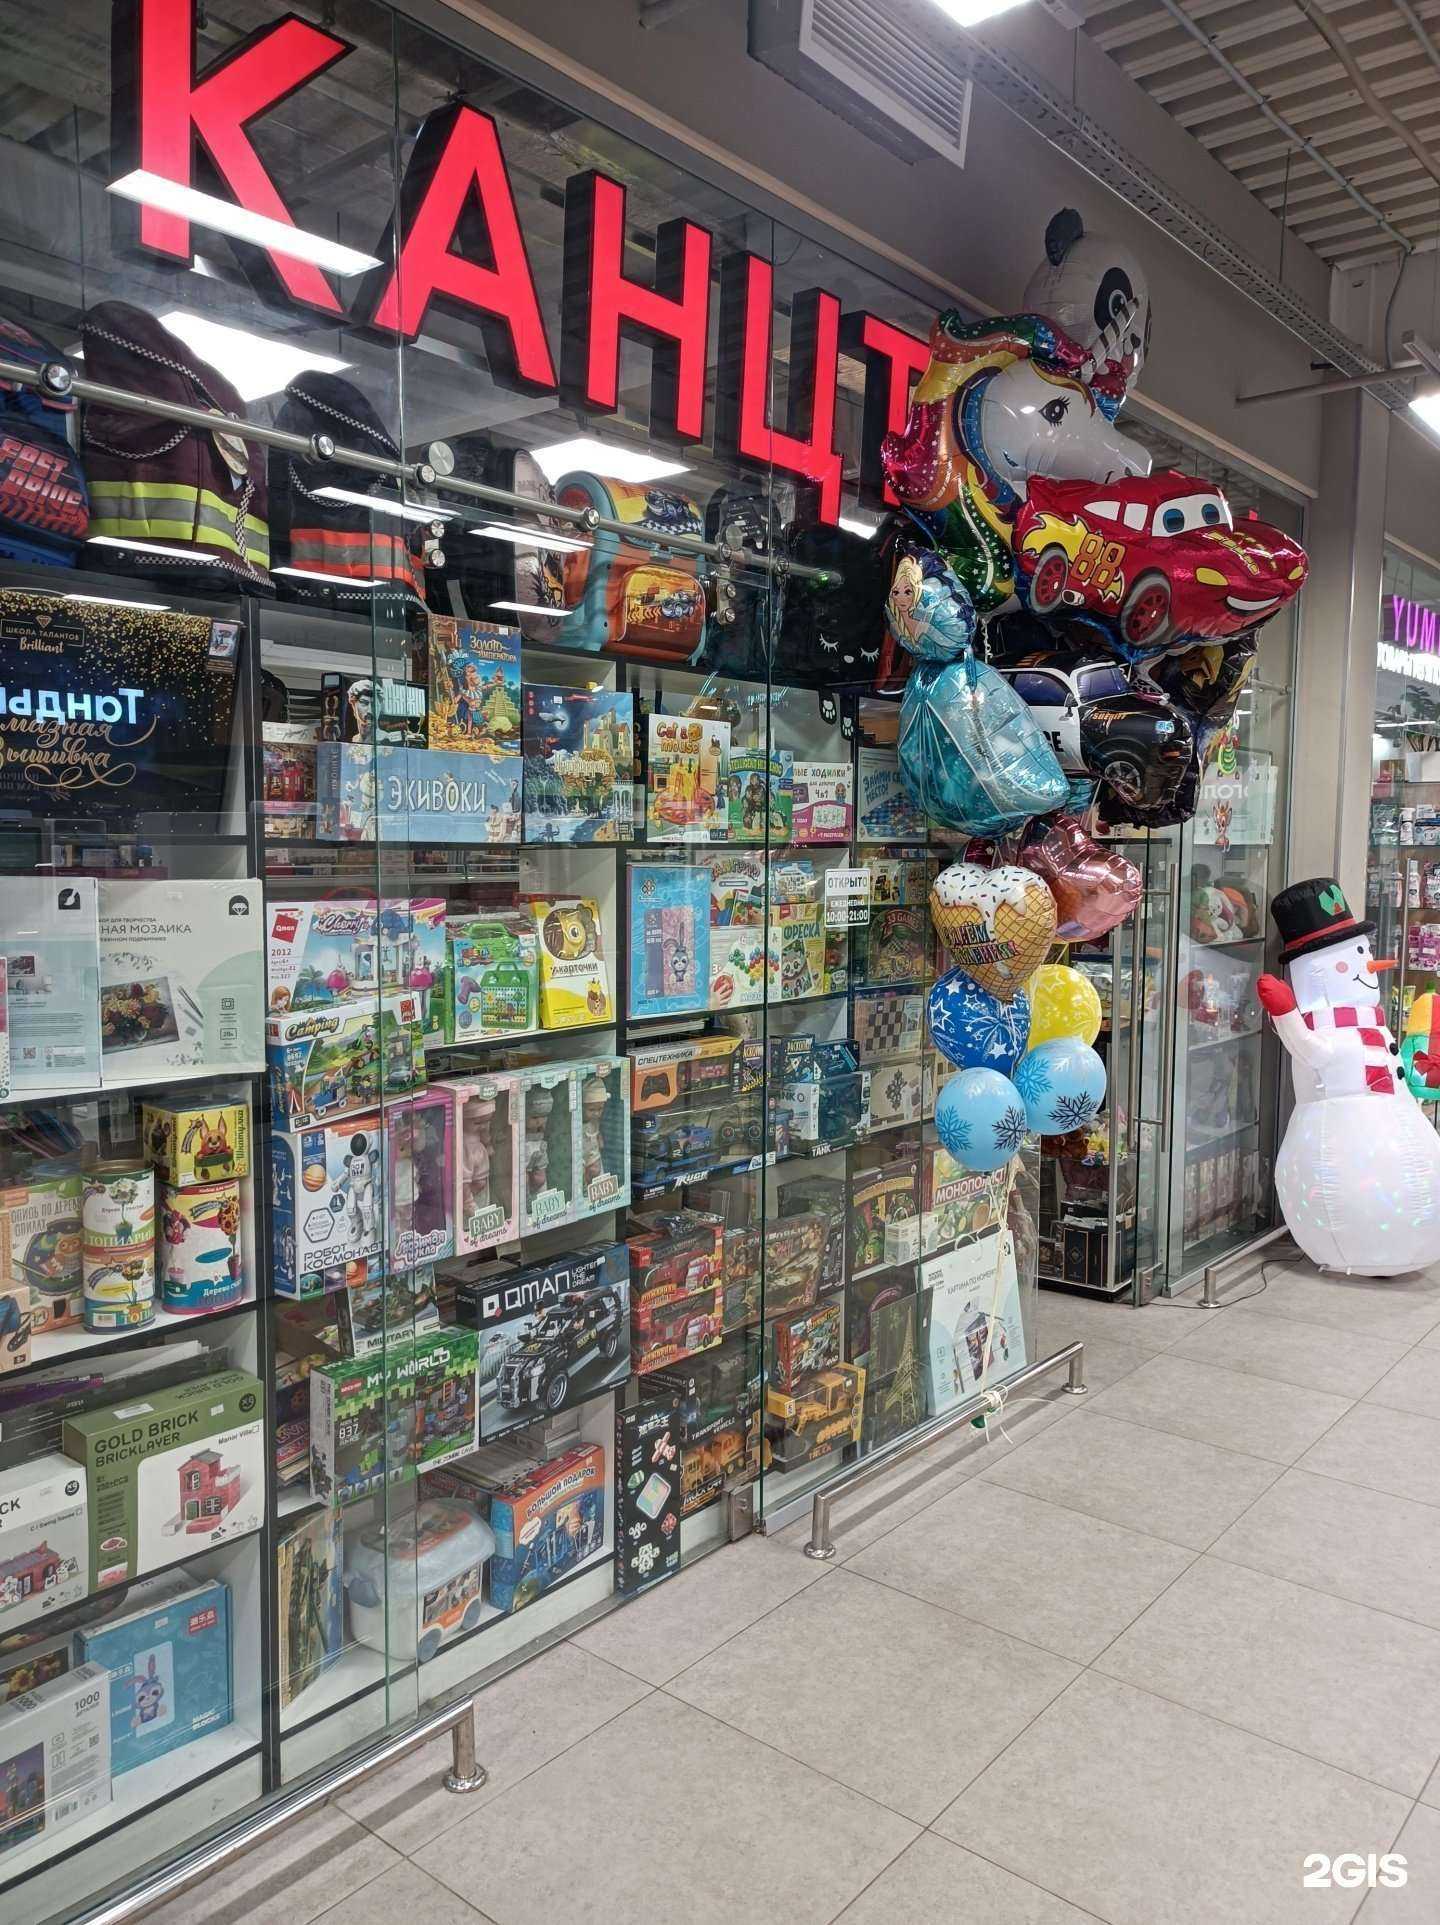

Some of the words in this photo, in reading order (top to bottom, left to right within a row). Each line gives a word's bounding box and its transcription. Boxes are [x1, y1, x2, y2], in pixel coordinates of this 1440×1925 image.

[1070, 532, 1127, 589] 88
[5, 626, 37, 636] ШКОЛА
[39, 630, 80, 641] ТАЛАНТОВ
[20, 637, 64, 654] Brilliant
[656, 722, 679, 739] Cat
[660, 740, 699, 754] mouse
[811, 768, 847, 778] ХОДИЛКИ
[388, 774, 487, 812] ЭКИВОКИ
[827, 876, 868, 889] ОТКРЫТО
[130, 924, 192, 934] МОЗАИКА
[783, 921, 821, 940] ФРЕСКА
[271, 949, 292, 957] 2012
[285, 1017, 340, 1041] Camping
[637, 1050, 694, 1066] СПЕЦТЕХНИКА
[591, 1182, 615, 1200] BABY
[535, 1198, 562, 1217] BABY
[472, 1214, 501, 1234] BABY
[479, 1227, 507, 1242] dreams
[304, 1243, 348, 1260] РОБОТ
[505, 1271, 571, 1311] QMAN
[366, 1328, 415, 1348] MILITARY
[94, 1428, 143, 1455] GOLD
[148, 1409, 200, 1441] BRICK
[339, 1422, 360, 1439] 837
[95, 1430, 181, 1468] BRICKLAYER
[526, 1480, 562, 1517] БОЛЬШОЙ
[561, 1465, 597, 1490] ПОДАРОК
[74, 1690, 101, 1712] 1000
